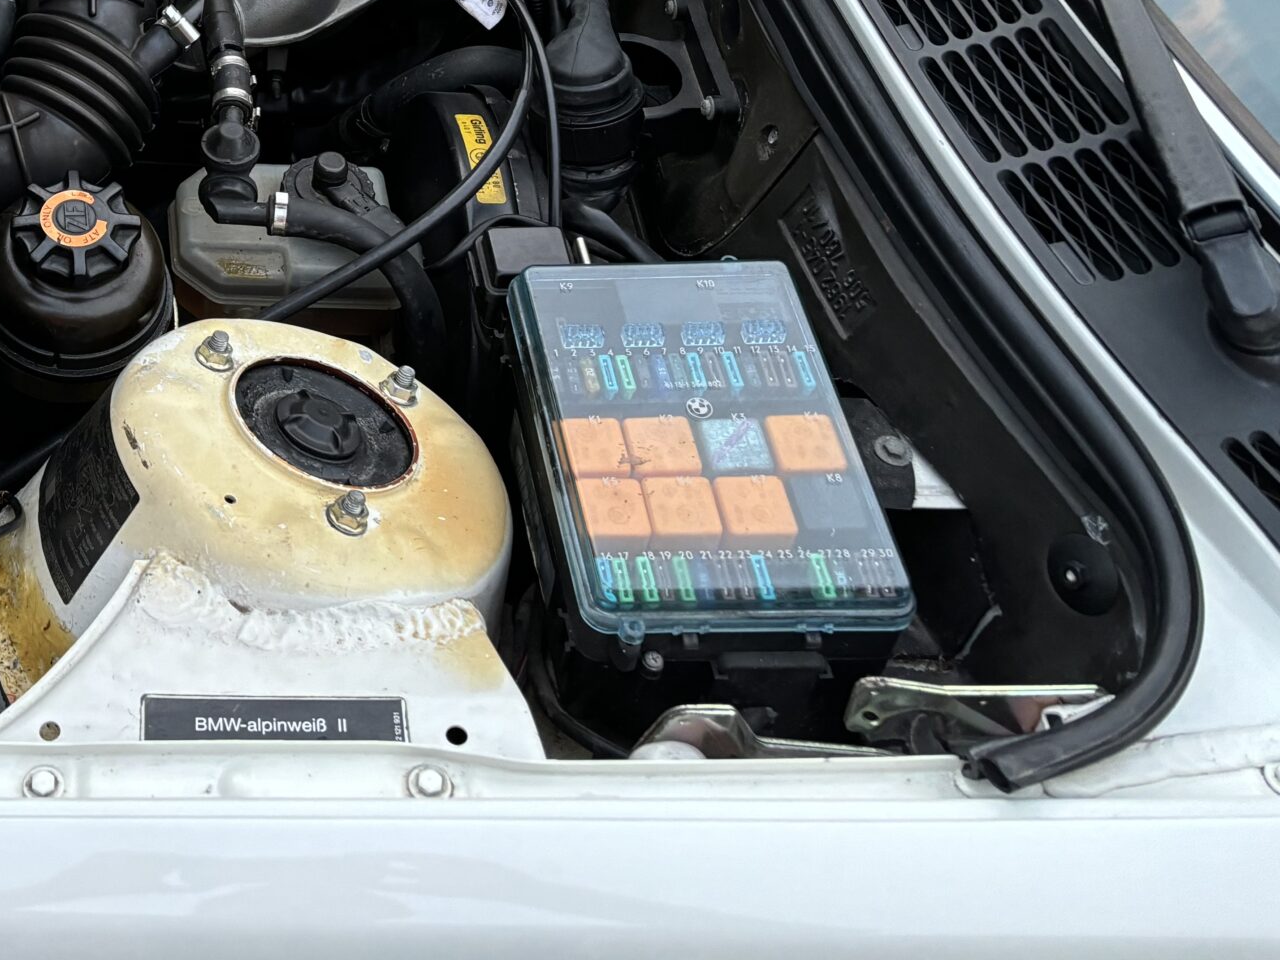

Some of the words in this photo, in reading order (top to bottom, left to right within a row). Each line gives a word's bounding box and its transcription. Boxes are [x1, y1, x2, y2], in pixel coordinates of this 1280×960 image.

[469, 118, 488, 144] Girling
[42, 205, 52, 227] ONLY
[65, 203, 89, 231] ZF
[57, 233, 72, 243] OIL
[83, 229, 99, 243] ATF
[560, 282, 574, 292] K9
[697, 280, 716, 290] K10
[731, 413, 746, 422] K3
[826, 474, 843, 482] K8
[618, 552, 628, 560] 17
[643, 552, 655, 560] 18
[659, 552, 671, 560] 19
[678, 551, 693, 559] 20
[700, 551, 711, 559] 21
[718, 551, 732, 559] 22
[738, 550, 752, 558] 23
[759, 550, 772, 558] 24
[777, 550, 793, 558] 25
[797, 549, 812, 558] 26
[835, 549, 851, 558] 28
[861, 549, 875, 558] 29
[879, 549, 894, 558] 30
[195, 717, 327, 735] BMW-alpinweiß
